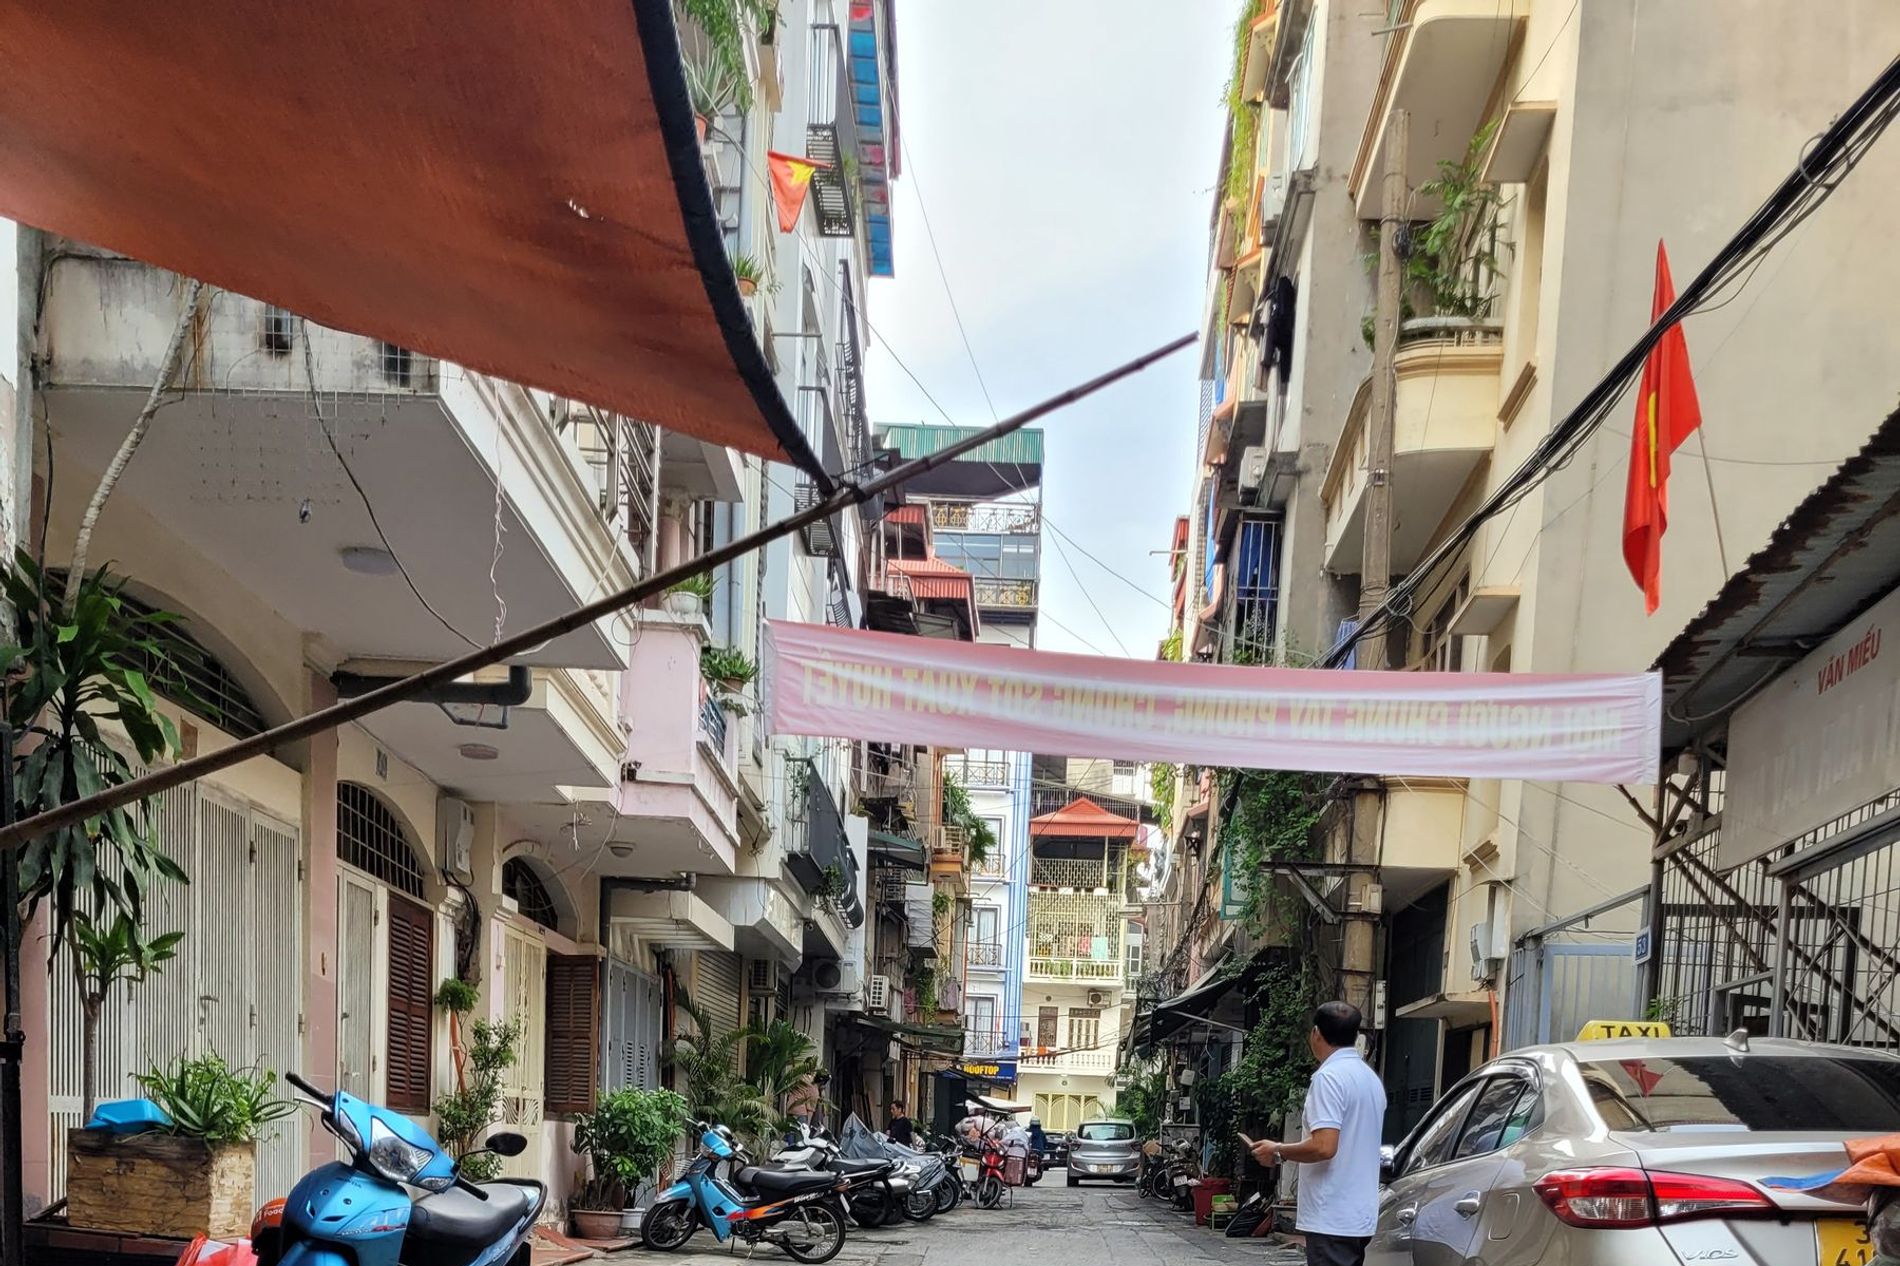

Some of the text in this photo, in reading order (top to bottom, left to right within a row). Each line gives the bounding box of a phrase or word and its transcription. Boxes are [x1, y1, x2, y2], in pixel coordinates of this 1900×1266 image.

[1817, 624, 1882, 695] VĂN MIẾU
[1600, 1025, 1660, 1038] TAXI
[964, 1064, 999, 1075] ROOFTOP
